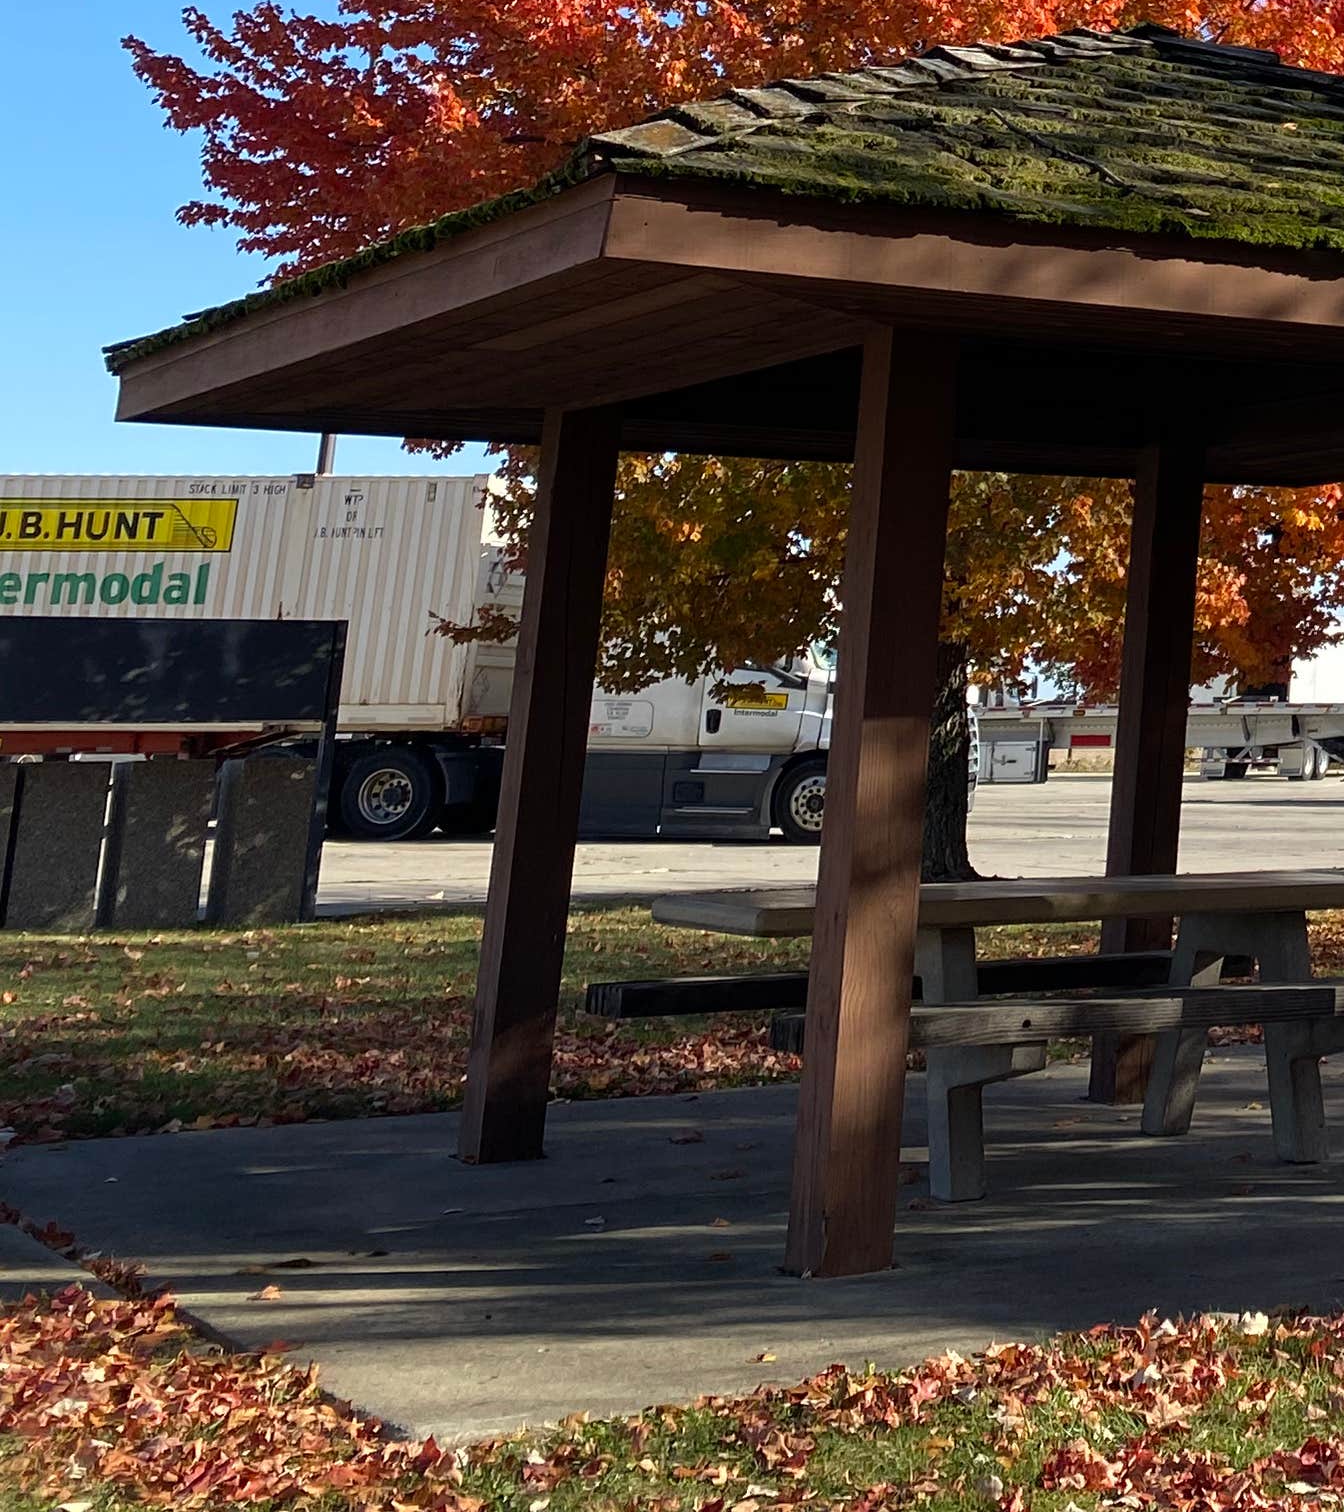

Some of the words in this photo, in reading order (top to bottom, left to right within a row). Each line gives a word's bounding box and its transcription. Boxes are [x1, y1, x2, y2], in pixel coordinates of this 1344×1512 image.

[263, 484, 286, 496] HIGH
[56, 511, 164, 540] HUNT
[0, 561, 210, 605] ermodal
[734, 709, 778, 717] Intermodal
